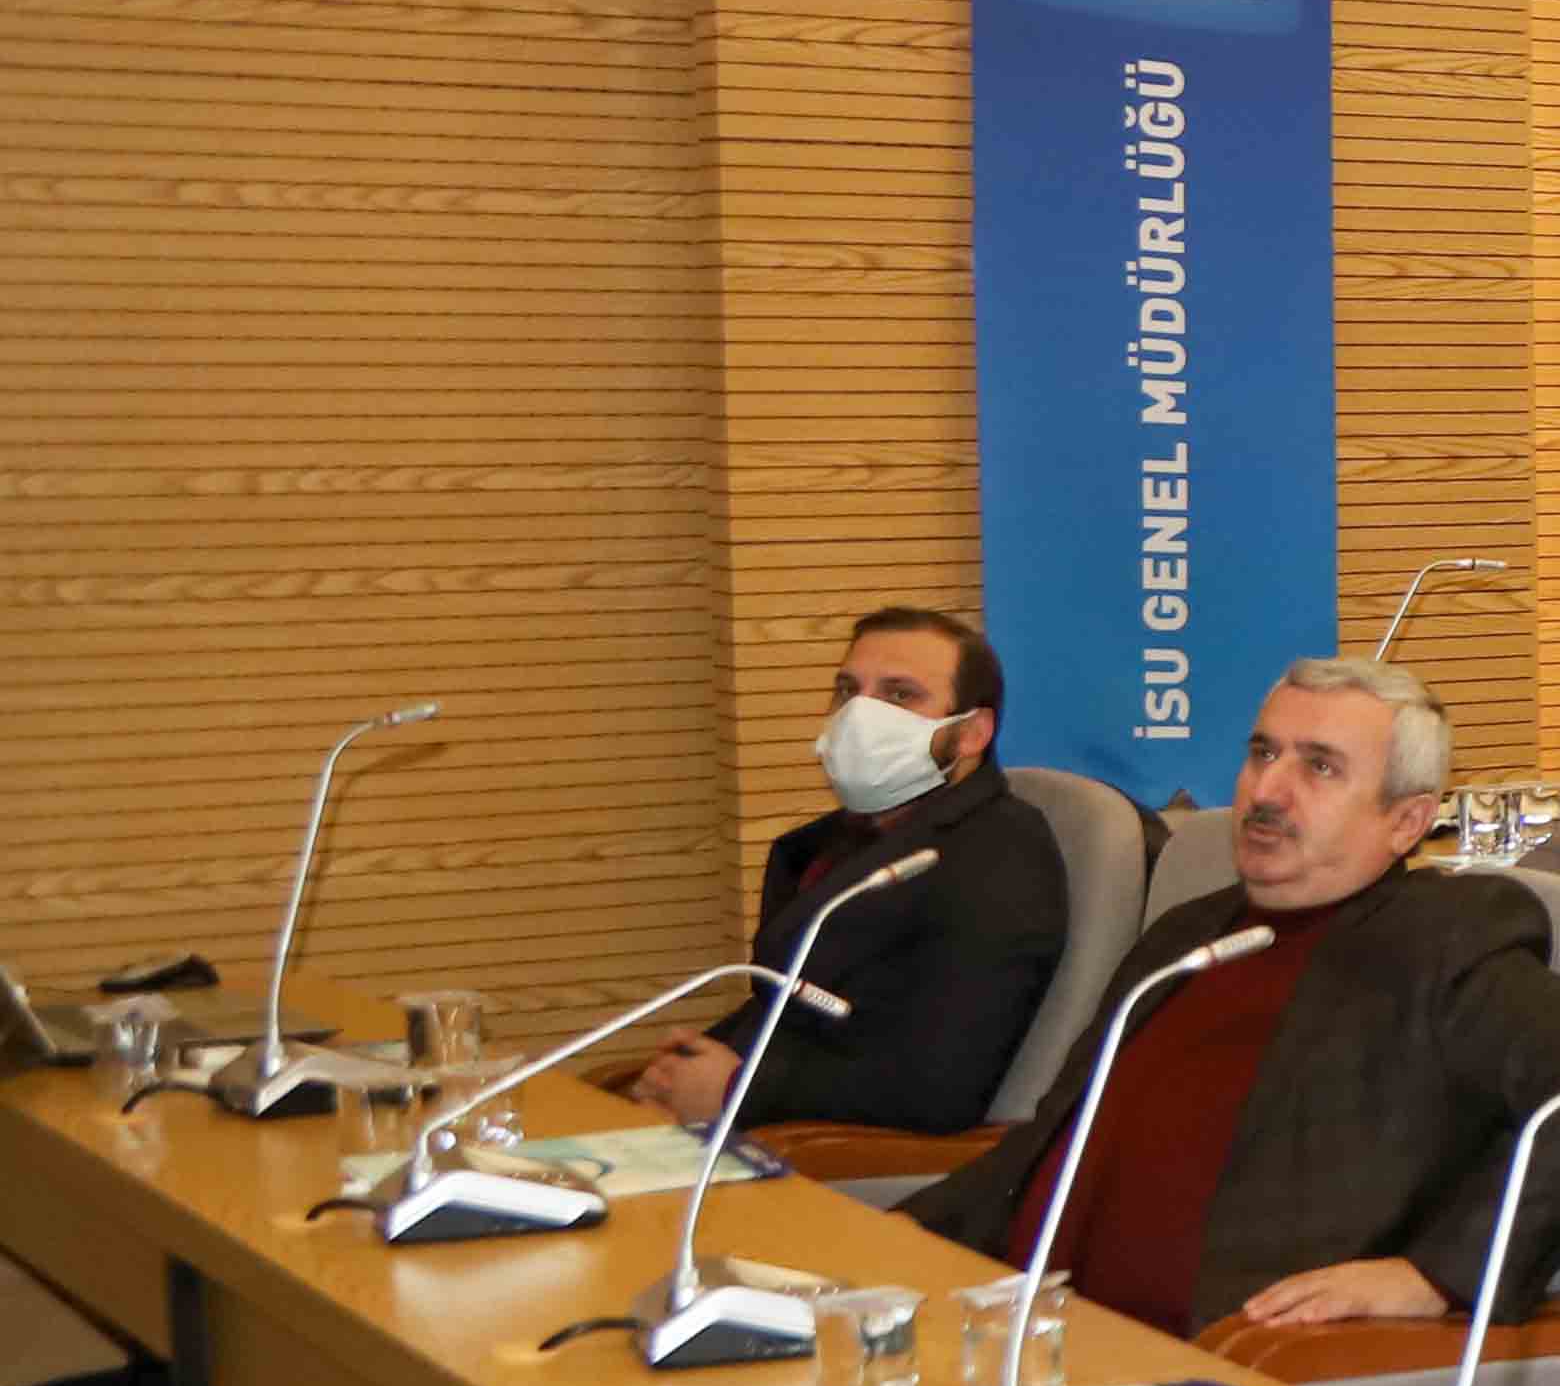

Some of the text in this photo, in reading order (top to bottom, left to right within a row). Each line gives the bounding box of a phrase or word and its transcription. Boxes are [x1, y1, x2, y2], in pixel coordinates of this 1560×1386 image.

[1124, 59, 1190, 740] İSU GENEL MÜDÜRLÜĞÜ
